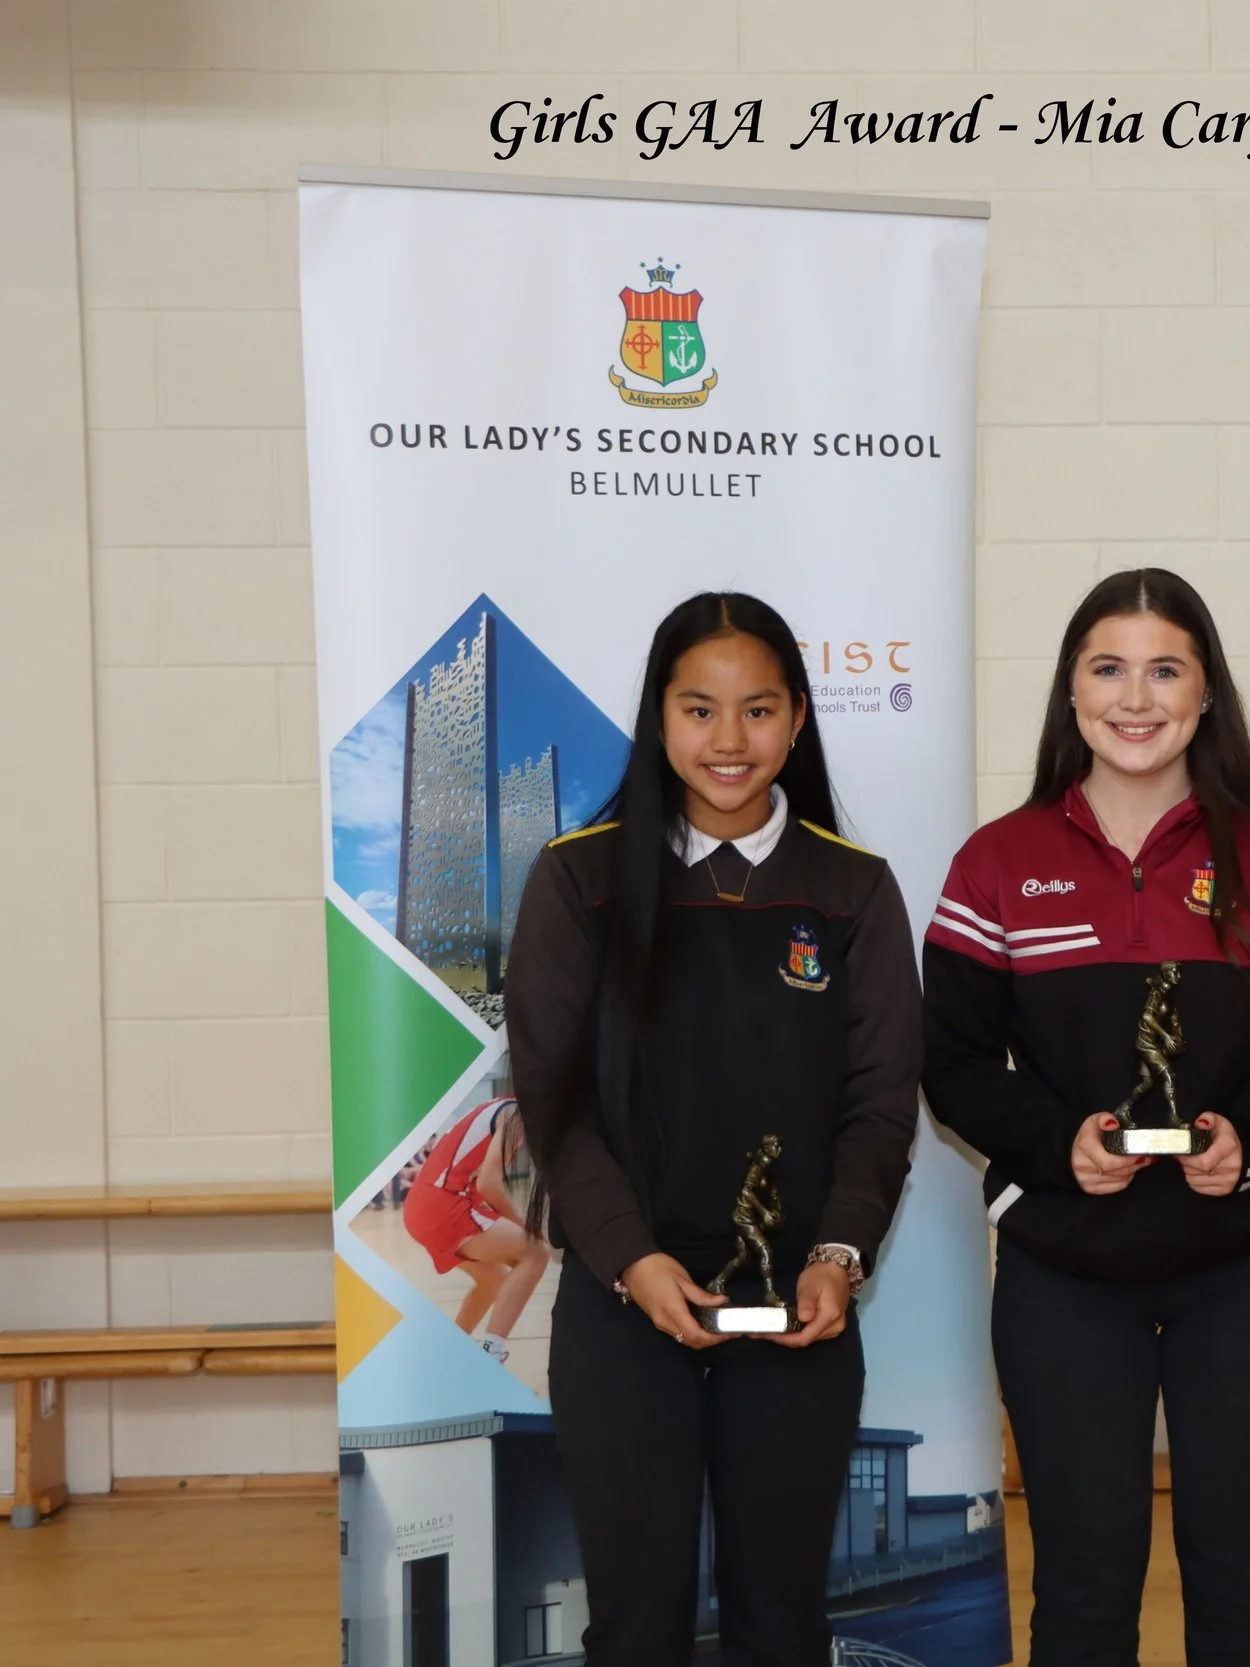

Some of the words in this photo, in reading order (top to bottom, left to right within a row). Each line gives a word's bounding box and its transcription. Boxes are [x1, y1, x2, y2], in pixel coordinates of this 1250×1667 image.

[629, 391, 701, 406] Misericordia
[370, 423, 448, 449] OUR
[464, 425, 582, 452] LADY'S
[597, 428, 798, 457] SECONDARY
[813, 432, 941, 459] SCHOOL
[570, 471, 762, 498] BELMULLET
[797, 641, 911, 674] IST
[811, 685, 881, 698] Education
[814, 701, 847, 714] hools
[849, 700, 881, 714] Trust
